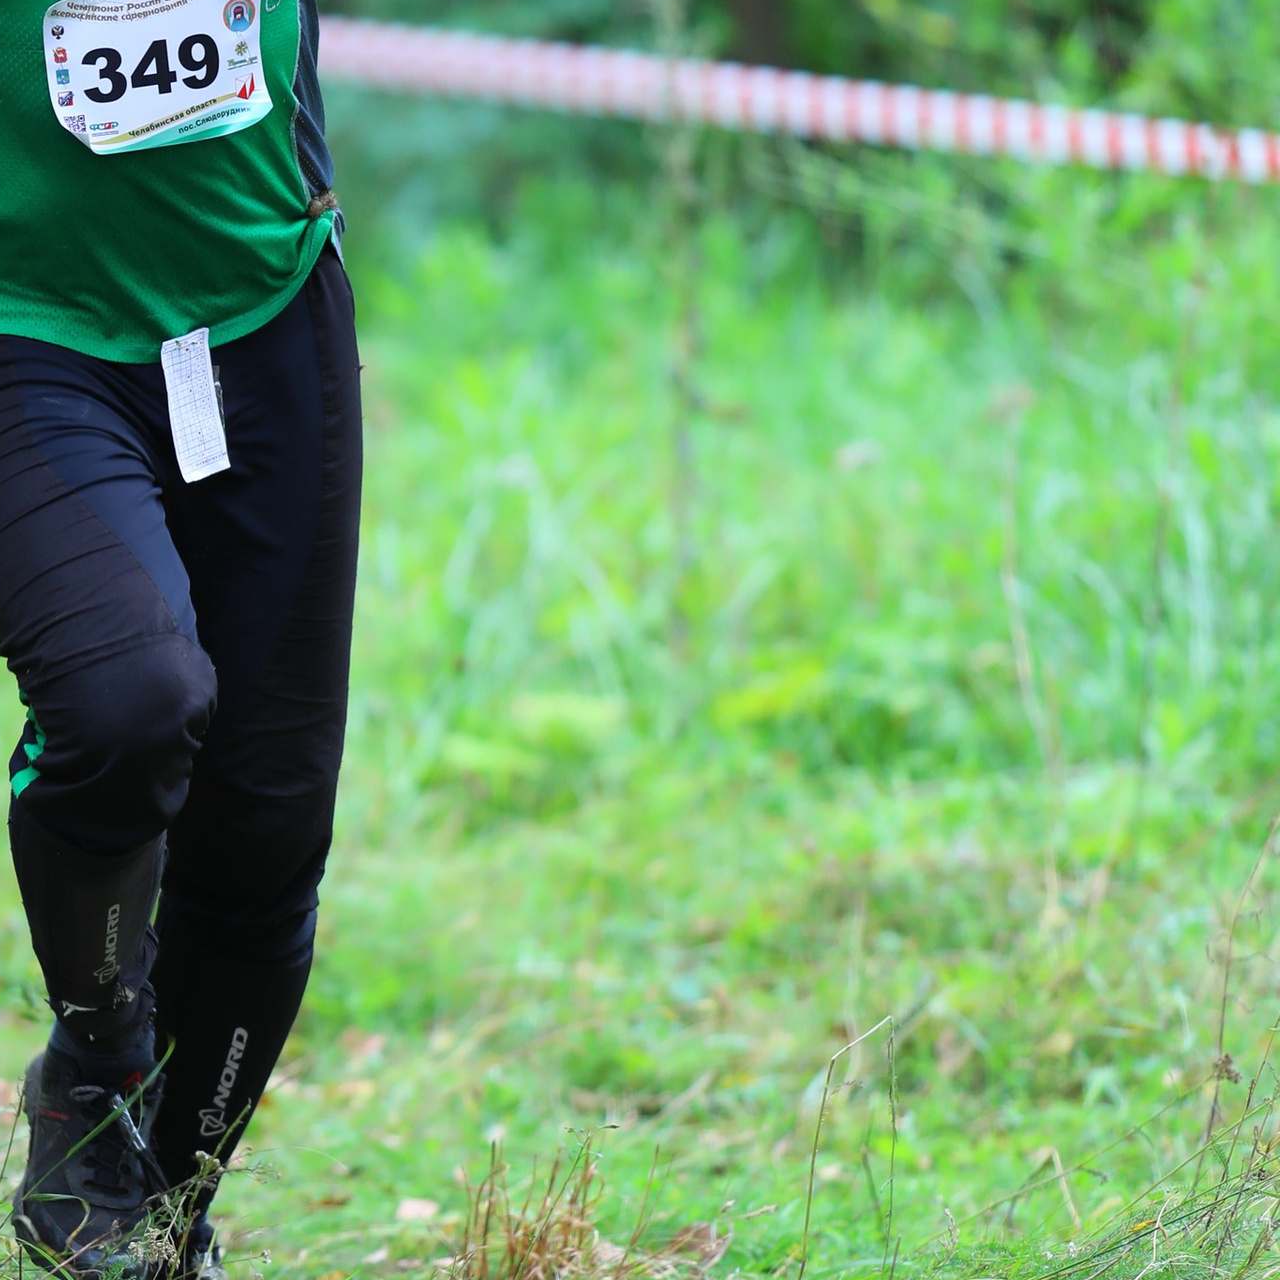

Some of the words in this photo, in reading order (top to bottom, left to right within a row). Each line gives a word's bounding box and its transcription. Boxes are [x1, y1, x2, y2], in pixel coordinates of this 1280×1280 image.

[50, 9, 118, 22] Всероссийские
[66, 1, 124, 13] Чемпионат
[81, 33, 220, 103] 349
[128, 112, 185, 138] Челябинская
[186, 98, 217, 116] область
[104, 903, 120, 962] NORD
[213, 1026, 248, 1109] NORD
